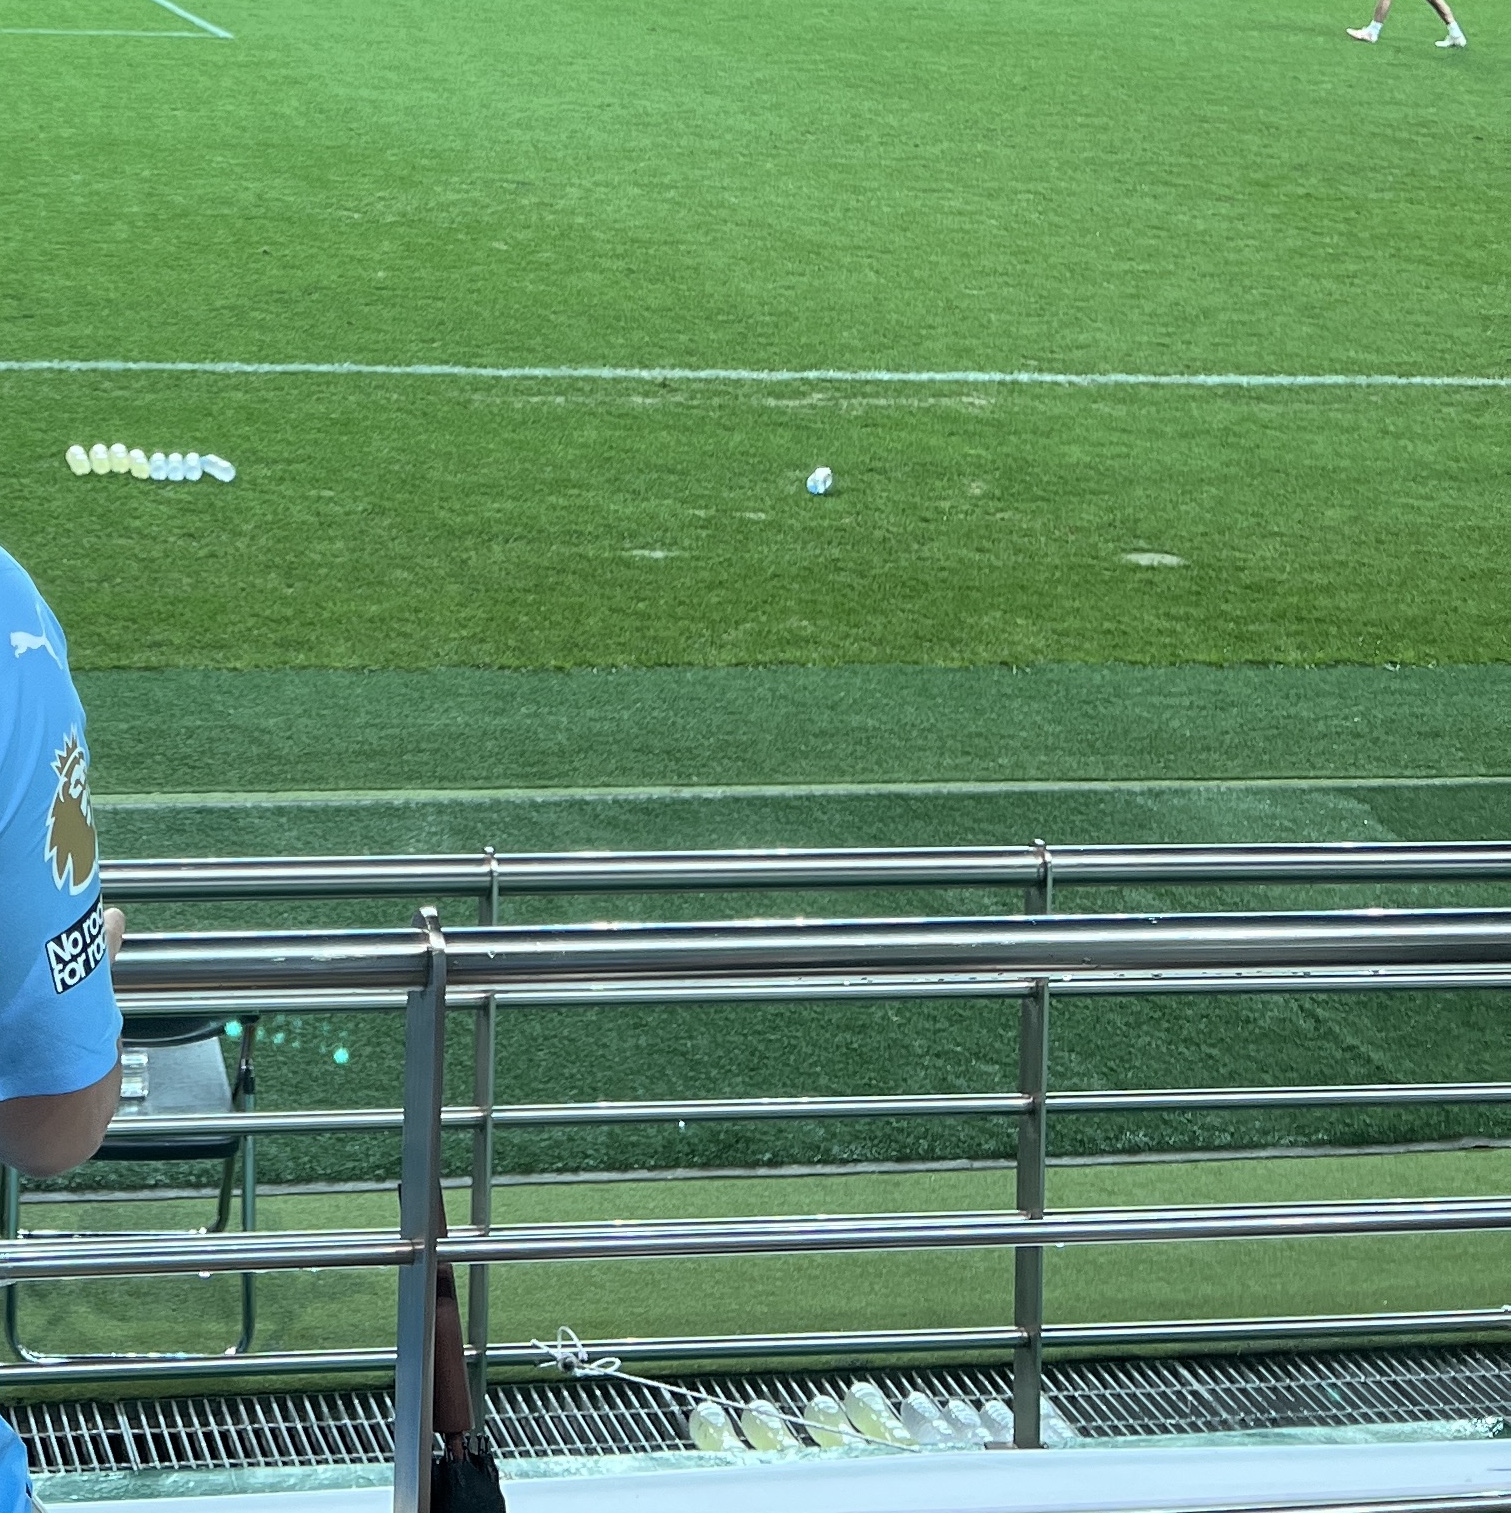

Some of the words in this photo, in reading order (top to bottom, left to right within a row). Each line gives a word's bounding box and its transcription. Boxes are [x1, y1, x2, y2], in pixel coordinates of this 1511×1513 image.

[46, 930, 84, 970] No
[82, 895, 104, 944] roo
[52, 952, 87, 993] For
